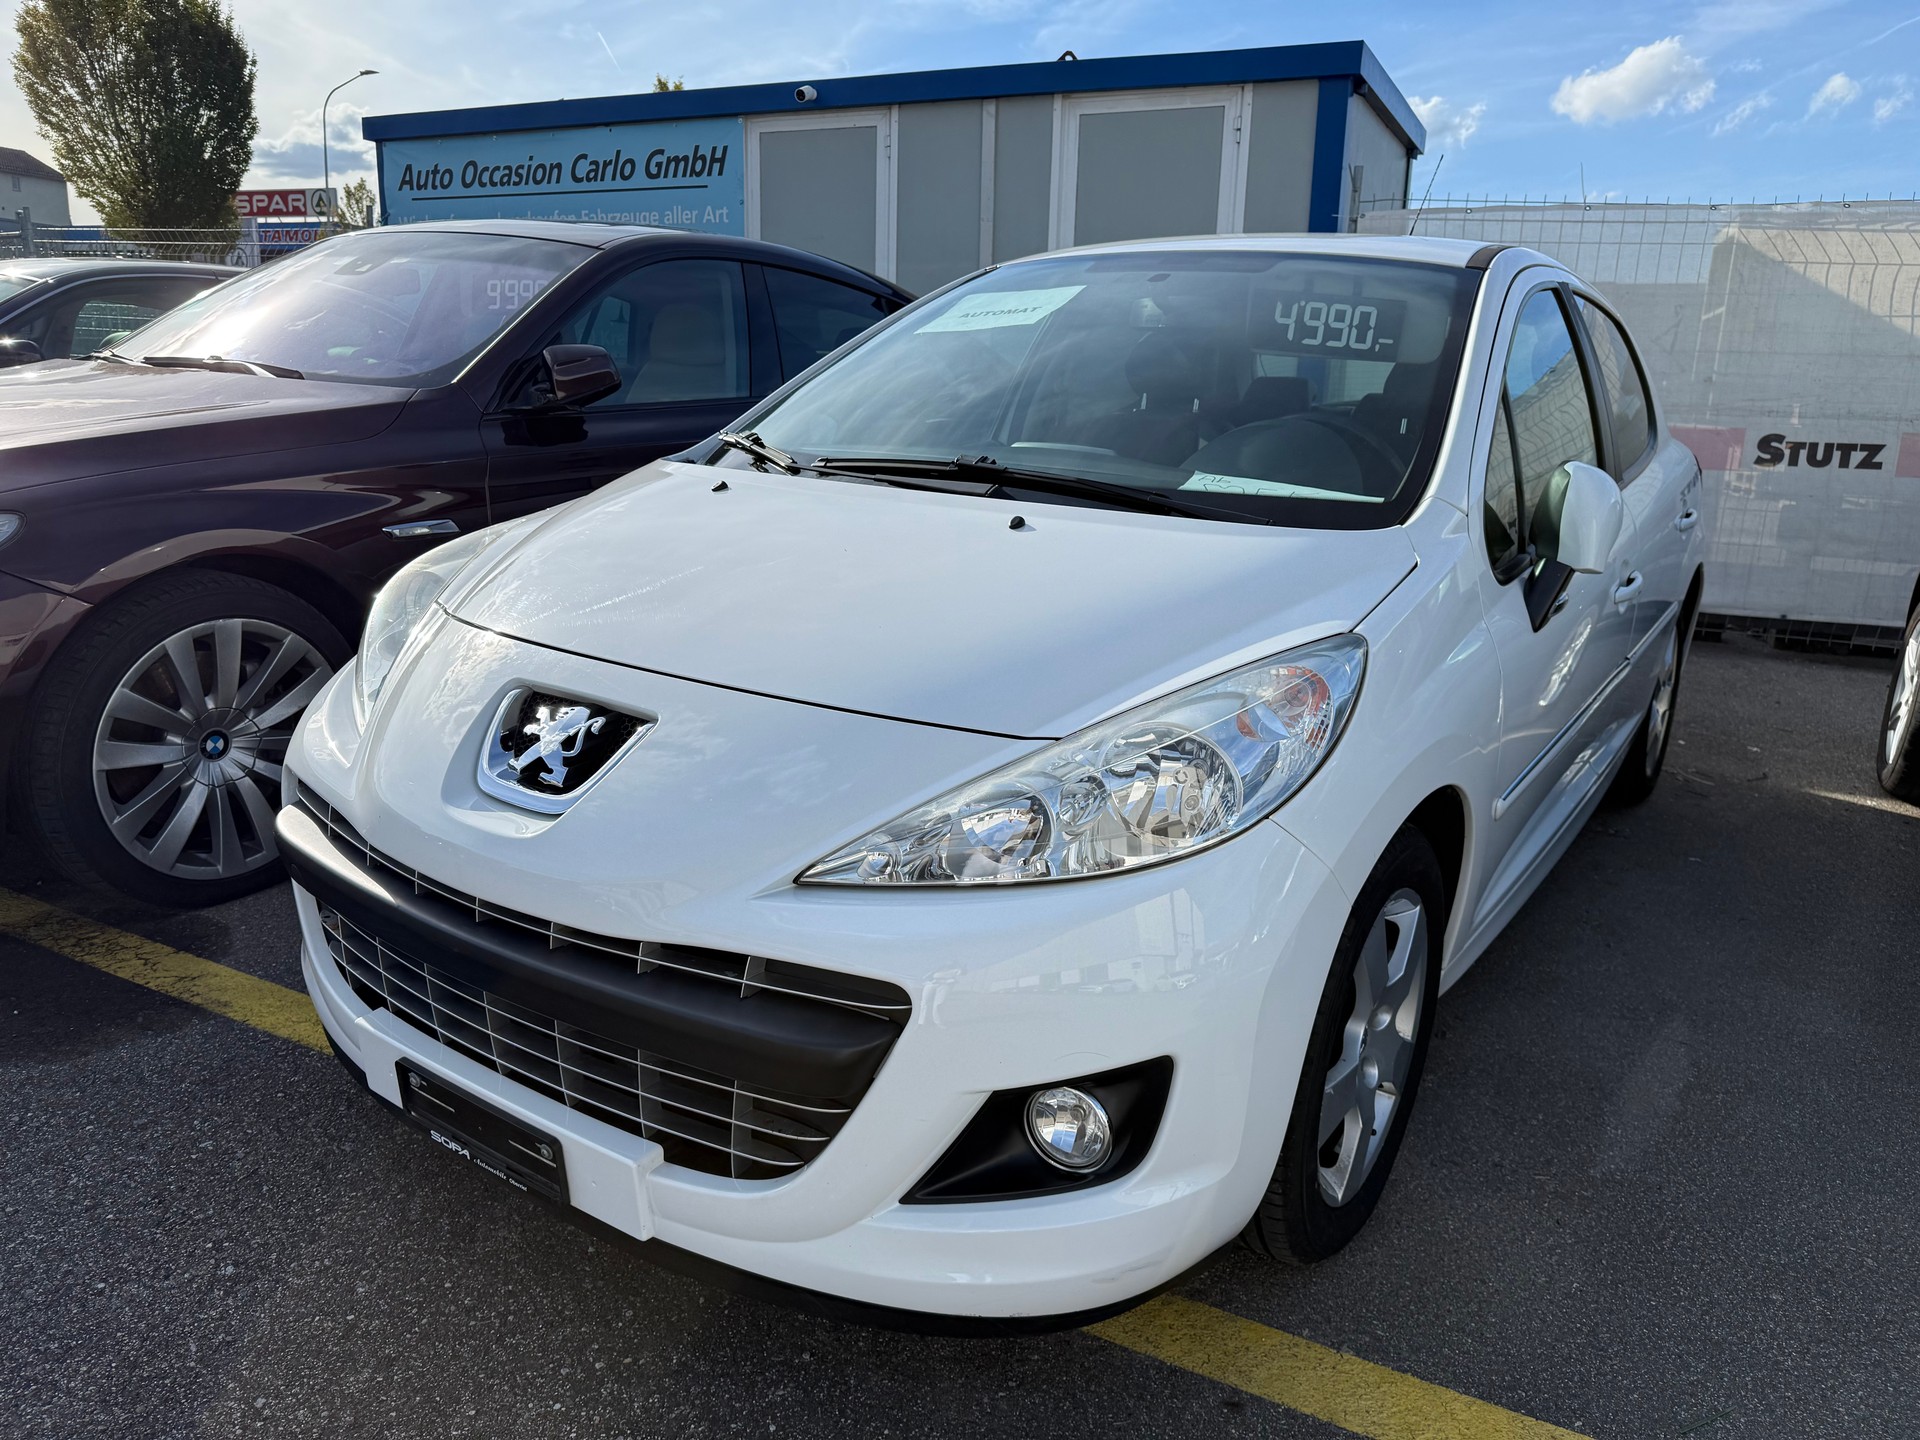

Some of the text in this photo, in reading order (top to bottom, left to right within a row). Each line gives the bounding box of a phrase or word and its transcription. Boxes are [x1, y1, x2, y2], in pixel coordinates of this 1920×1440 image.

[398, 144, 729, 192] Auto Occasion Carlo GmbH
[235, 194, 306, 213] SPAR
[664, 205, 698, 224] aller
[702, 205, 729, 224] Art
[958, 306, 1043, 319] AUTOMAT
[430, 1130, 470, 1160] SOPA
